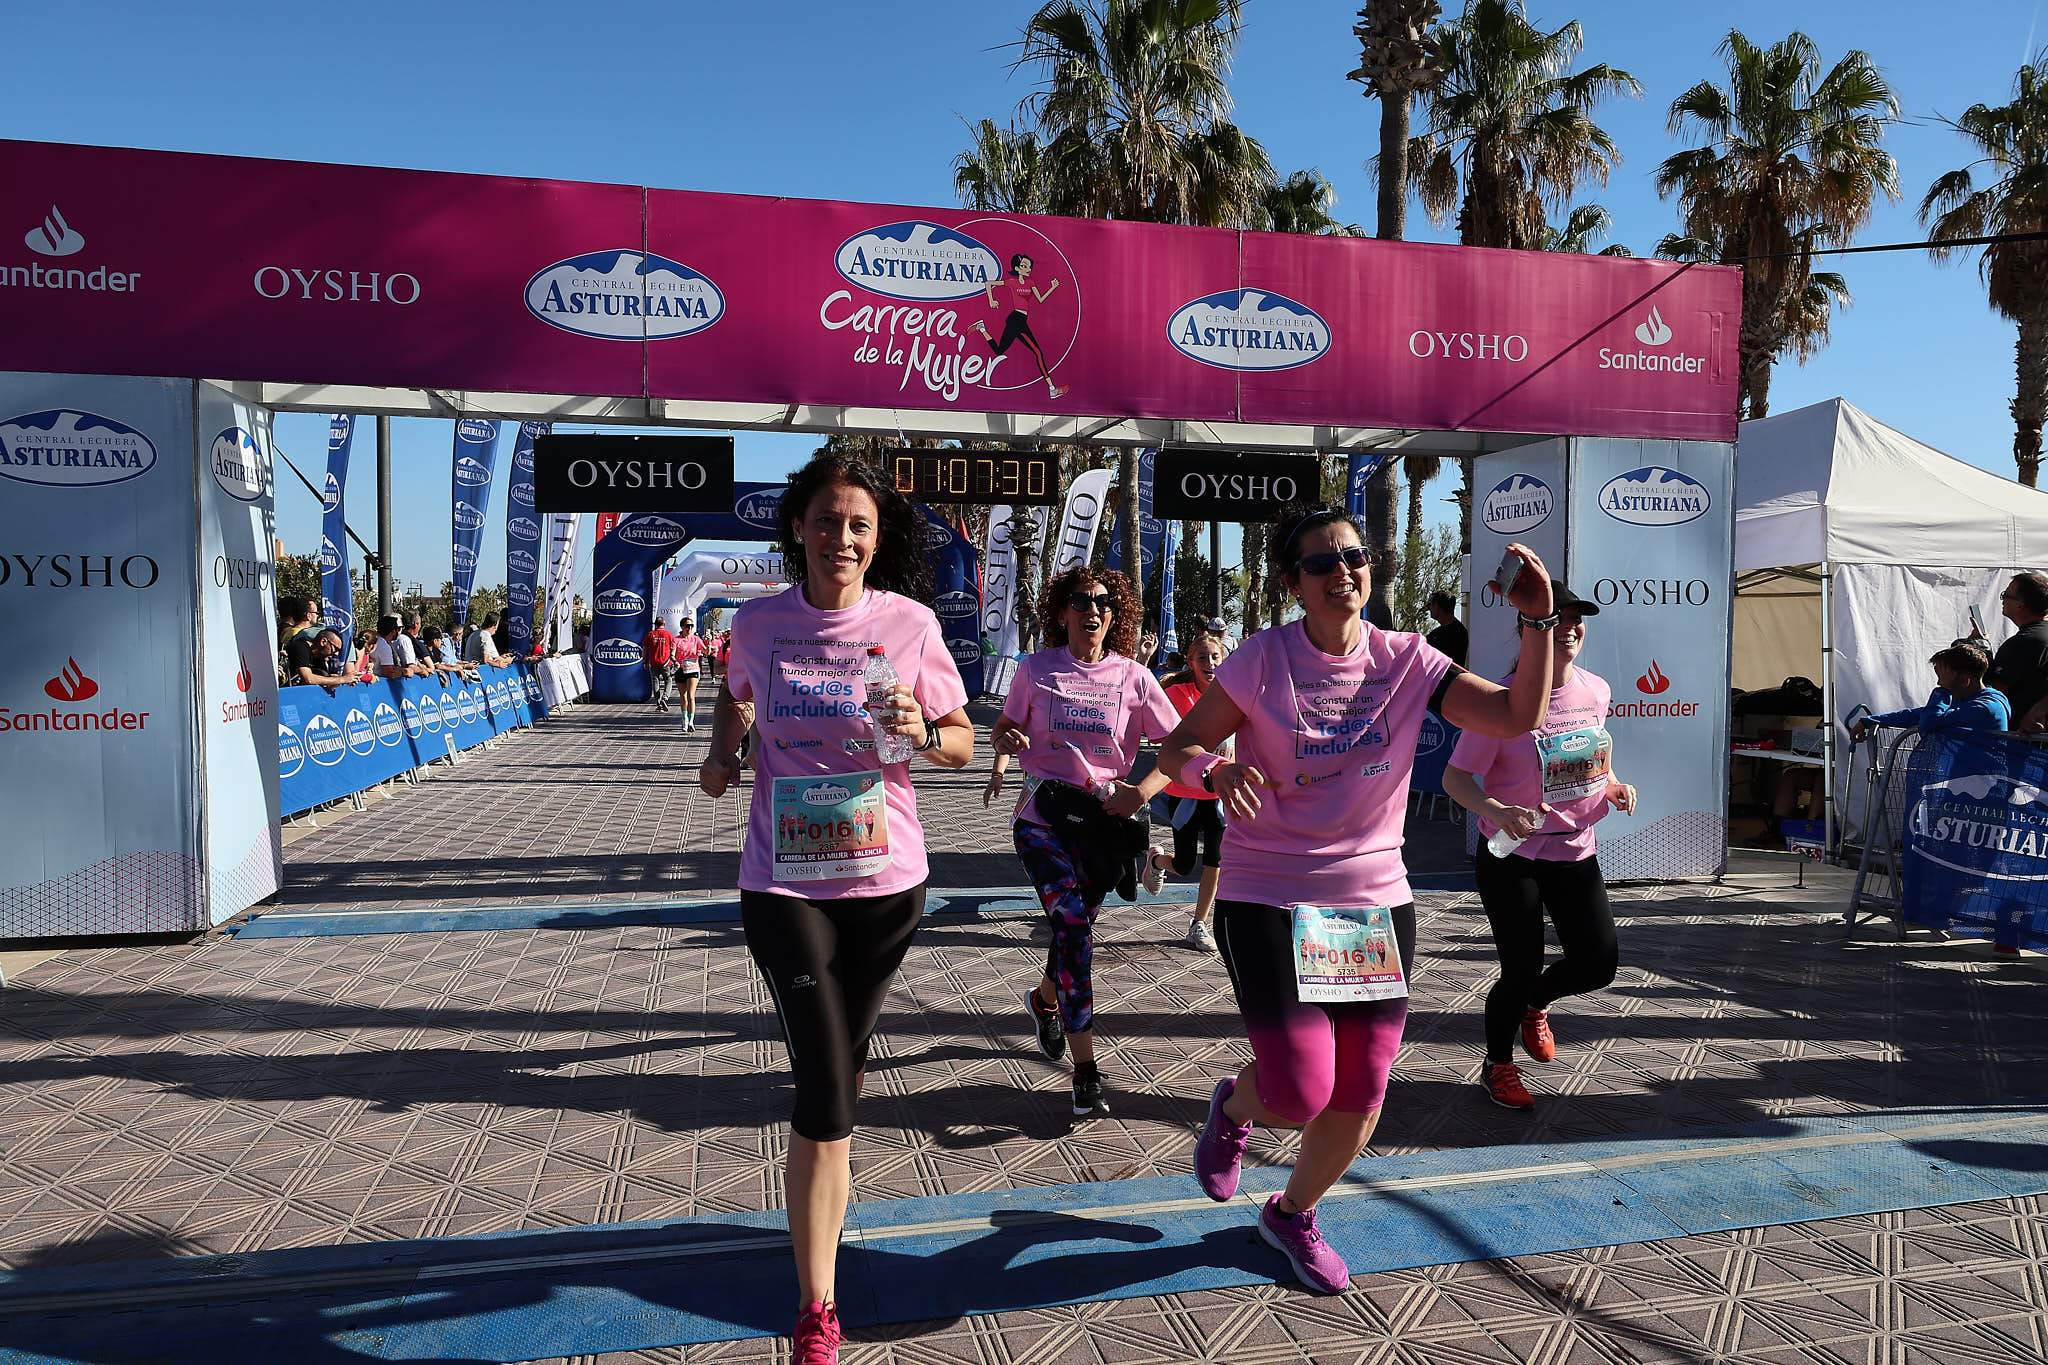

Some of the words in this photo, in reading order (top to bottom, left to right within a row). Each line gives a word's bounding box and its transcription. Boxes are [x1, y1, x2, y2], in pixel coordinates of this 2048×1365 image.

[875, 246, 927, 257] CENTRAL
[932, 250, 985, 260] LECHERA
[848, 246, 988, 283] ASTURIANA
[0, 262, 141, 292] antander
[254, 266, 420, 304] OYSHO
[572, 279, 635, 290] CENTRAL
[541, 279, 710, 319] ASTURIANA
[820, 290, 957, 337] Carrera
[1206, 315, 1257, 325] CENTRAL
[1262, 318, 1314, 328] LECHERA
[1180, 315, 1320, 352] ASTURIANA
[1408, 330, 1529, 362] OYSHO
[854, 336, 879, 364] de
[885, 336, 903, 366] la
[900, 335, 1007, 401] Mujer
[1599, 348, 1705, 373] Santander
[16, 435, 74, 444] CENTRAL
[80, 437, 137, 446] LECHERA
[215, 447, 265, 488] ASTURIANA
[567, 459, 708, 490] OYSHO
[1181, 472, 1297, 501] OYSHO
[1624, 486, 1657, 494] CENTRAL
[1659, 487, 1699, 495] LECHERA
[1606, 487, 1702, 512] ASTURIANA
[1485, 499, 1547, 522] ASTURIANA
[623, 526, 680, 540] ASTURIANA
[0, 555, 159, 589] YSHO
[214, 555, 269, 591] OYSHO
[721, 558, 783, 575] OYSH
[1594, 578, 1710, 606] OYSHO
[596, 599, 641, 611] ASTURIANA
[595, 648, 640, 659] ASTURIANA
[793, 654, 841, 666] Construir
[778, 667, 814, 677] mundo
[817, 669, 847, 678] mejor
[790, 680, 853, 696] Tod@s
[1066, 689, 1098, 698] Construir
[1056, 696, 1081, 704] mundo
[1082, 699, 1102, 707] mejor
[1313, 694, 1358, 705] Construir
[222, 698, 267, 723] Santander
[774, 700, 868, 718] incluid@s
[1064, 705, 1105, 720] Tod@s
[1302, 707, 1337, 718] mundo
[1339, 706, 1368, 717] mejor
[1607, 699, 1699, 719] Santander
[0, 708, 150, 731] Santander
[1054, 719, 1112, 735] incluid@s
[1316, 718, 1374, 736] Tod@s
[1545, 721, 1578, 729] Construir
[308, 736, 345, 756] ASTURIANA
[1304, 731, 1383, 755] inclui@s
[805, 790, 848, 801] ASTURIANA
[1944, 802, 2005, 819] CENTRAL
[2010, 812, 2048, 826] LECH
[808, 821, 852, 840] 016
[780, 854, 807, 862] CARRERA
[853, 848, 883, 857] VALENCIA
[819, 843, 840, 851] 2367
[786, 866, 821, 875] OYSHO
[844, 862, 879, 872] Santander
[1327, 949, 1366, 965] 016
[1337, 968, 1356, 976] 5735
[1310, 988, 1342, 996] OYSHO
[1362, 986, 1394, 994] Santander
